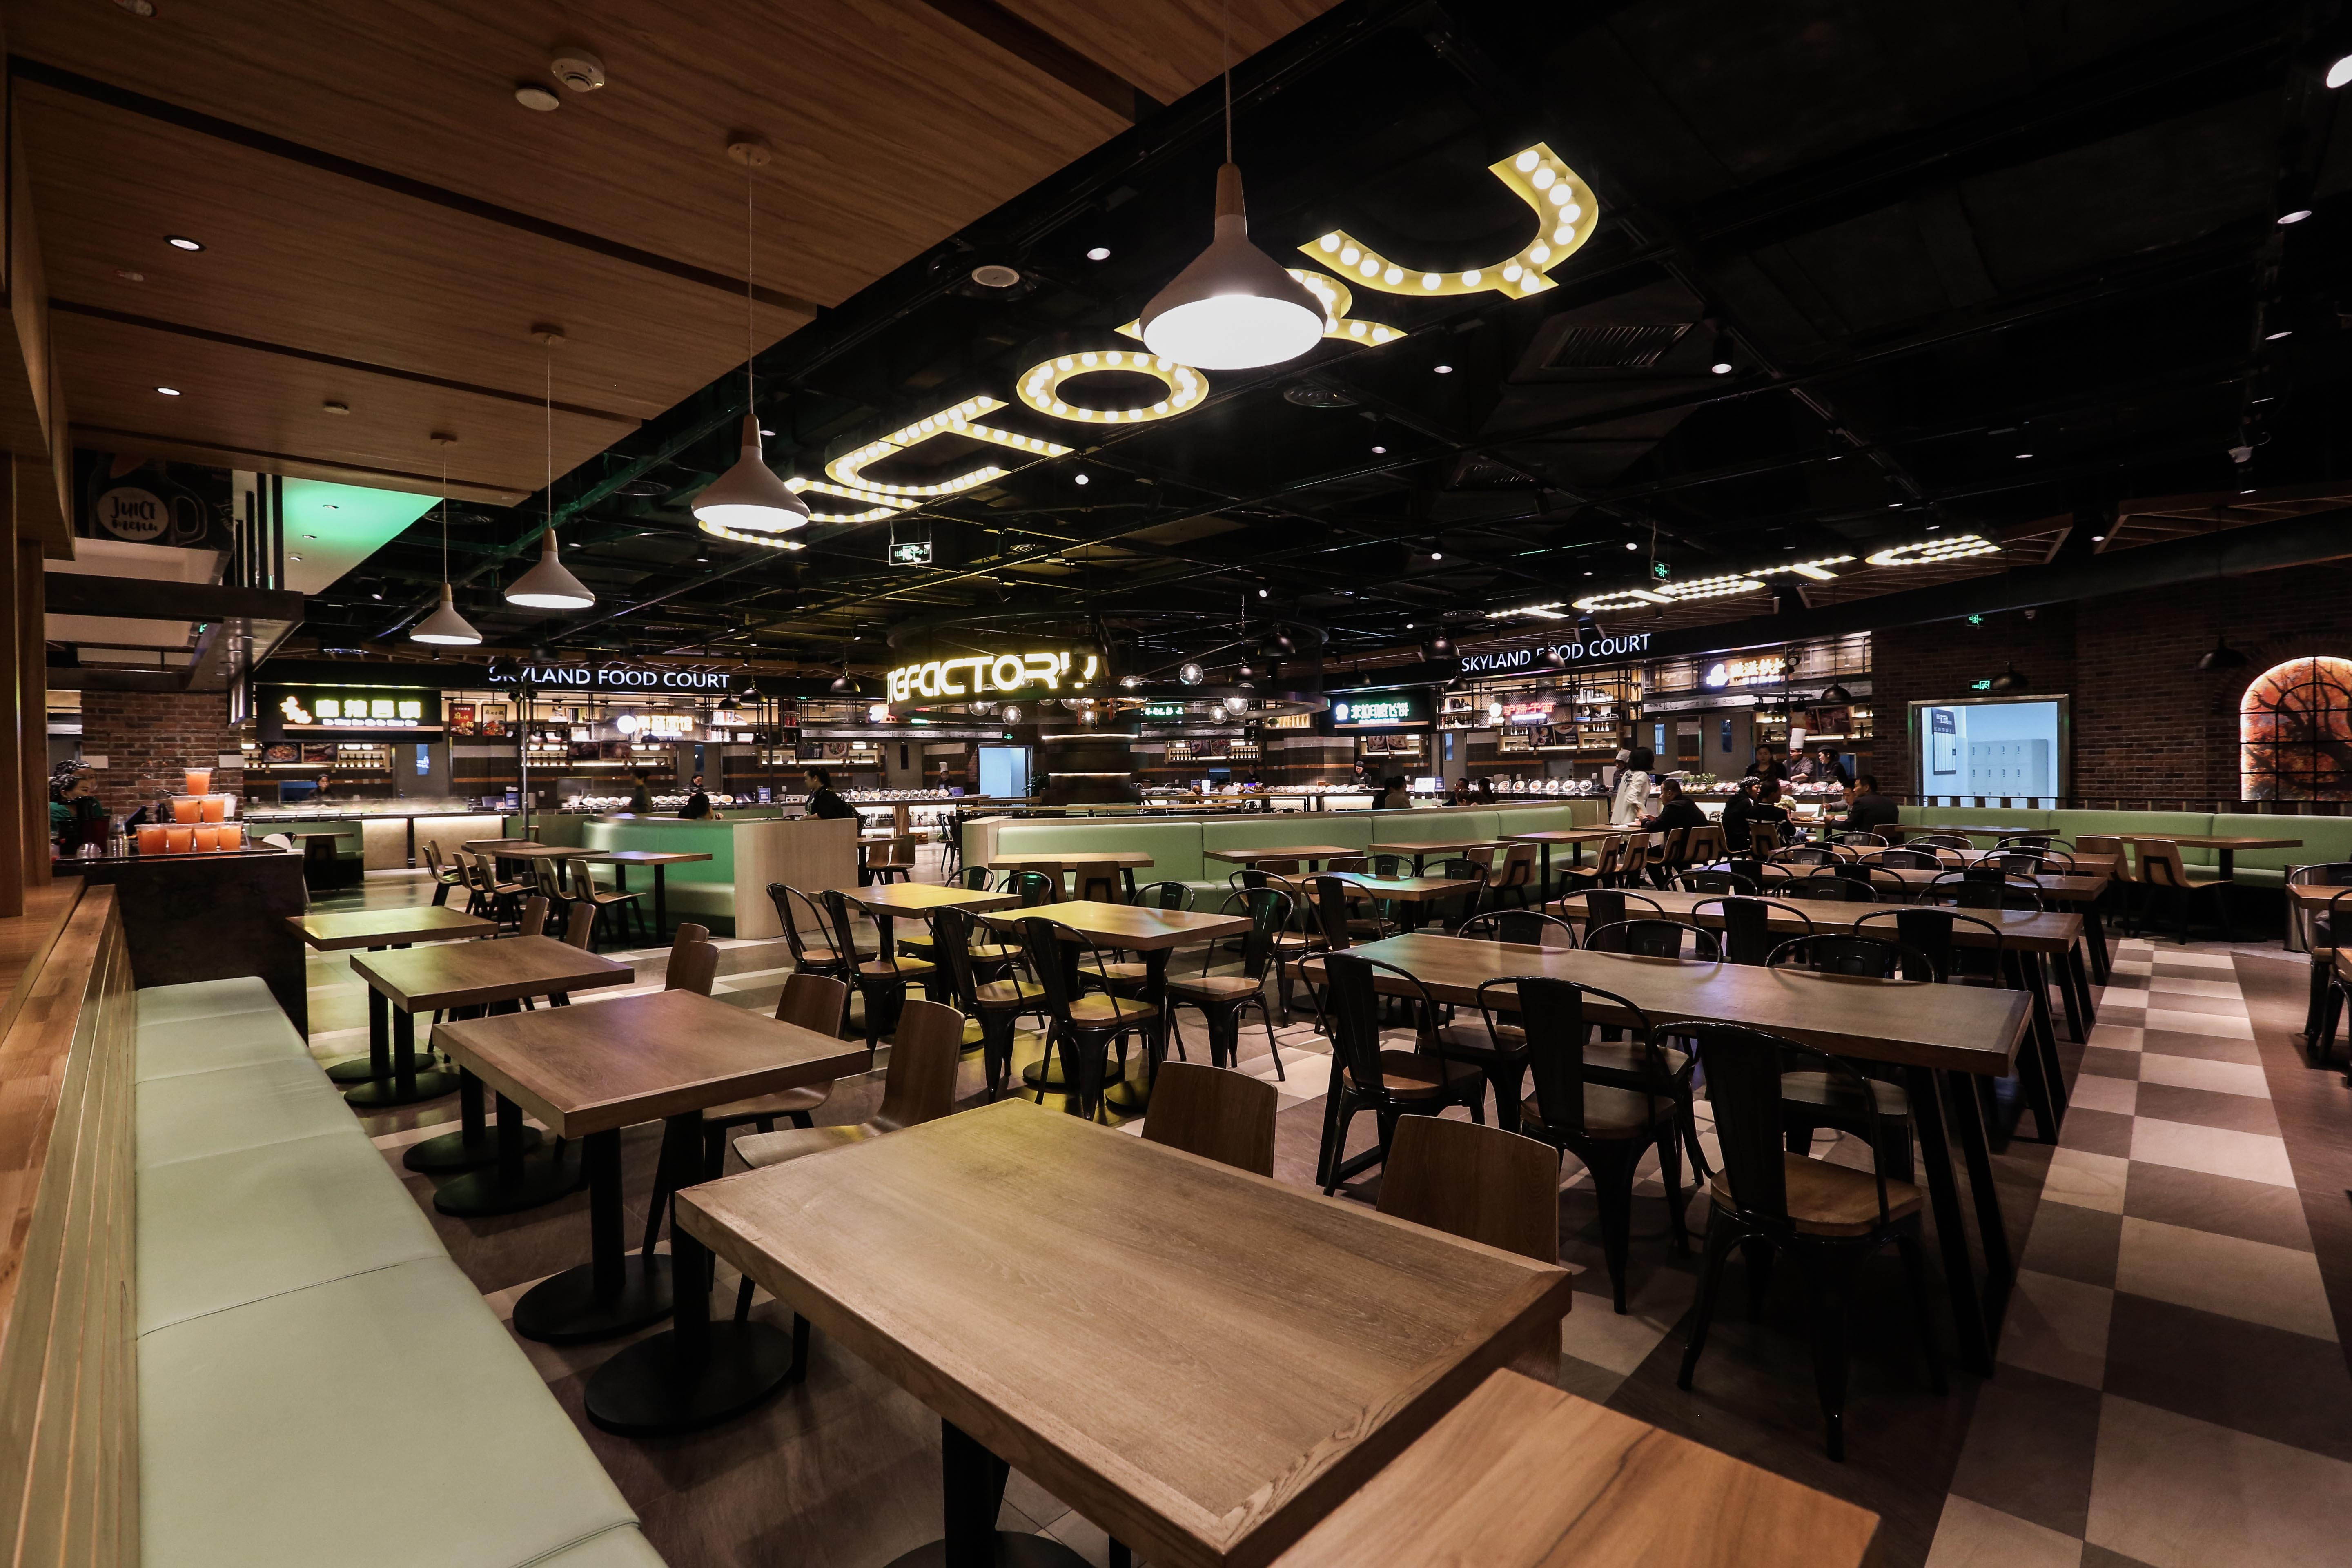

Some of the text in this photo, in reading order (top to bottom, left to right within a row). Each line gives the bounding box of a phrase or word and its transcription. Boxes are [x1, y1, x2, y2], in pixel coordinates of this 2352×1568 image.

[1461, 633, 1651, 672] SKYLAND FOD COURT
[598, 669, 658, 686] FOOD
[663, 672, 730, 688] COURT
[1503, 702, 1555, 716] 驴蹄子面
